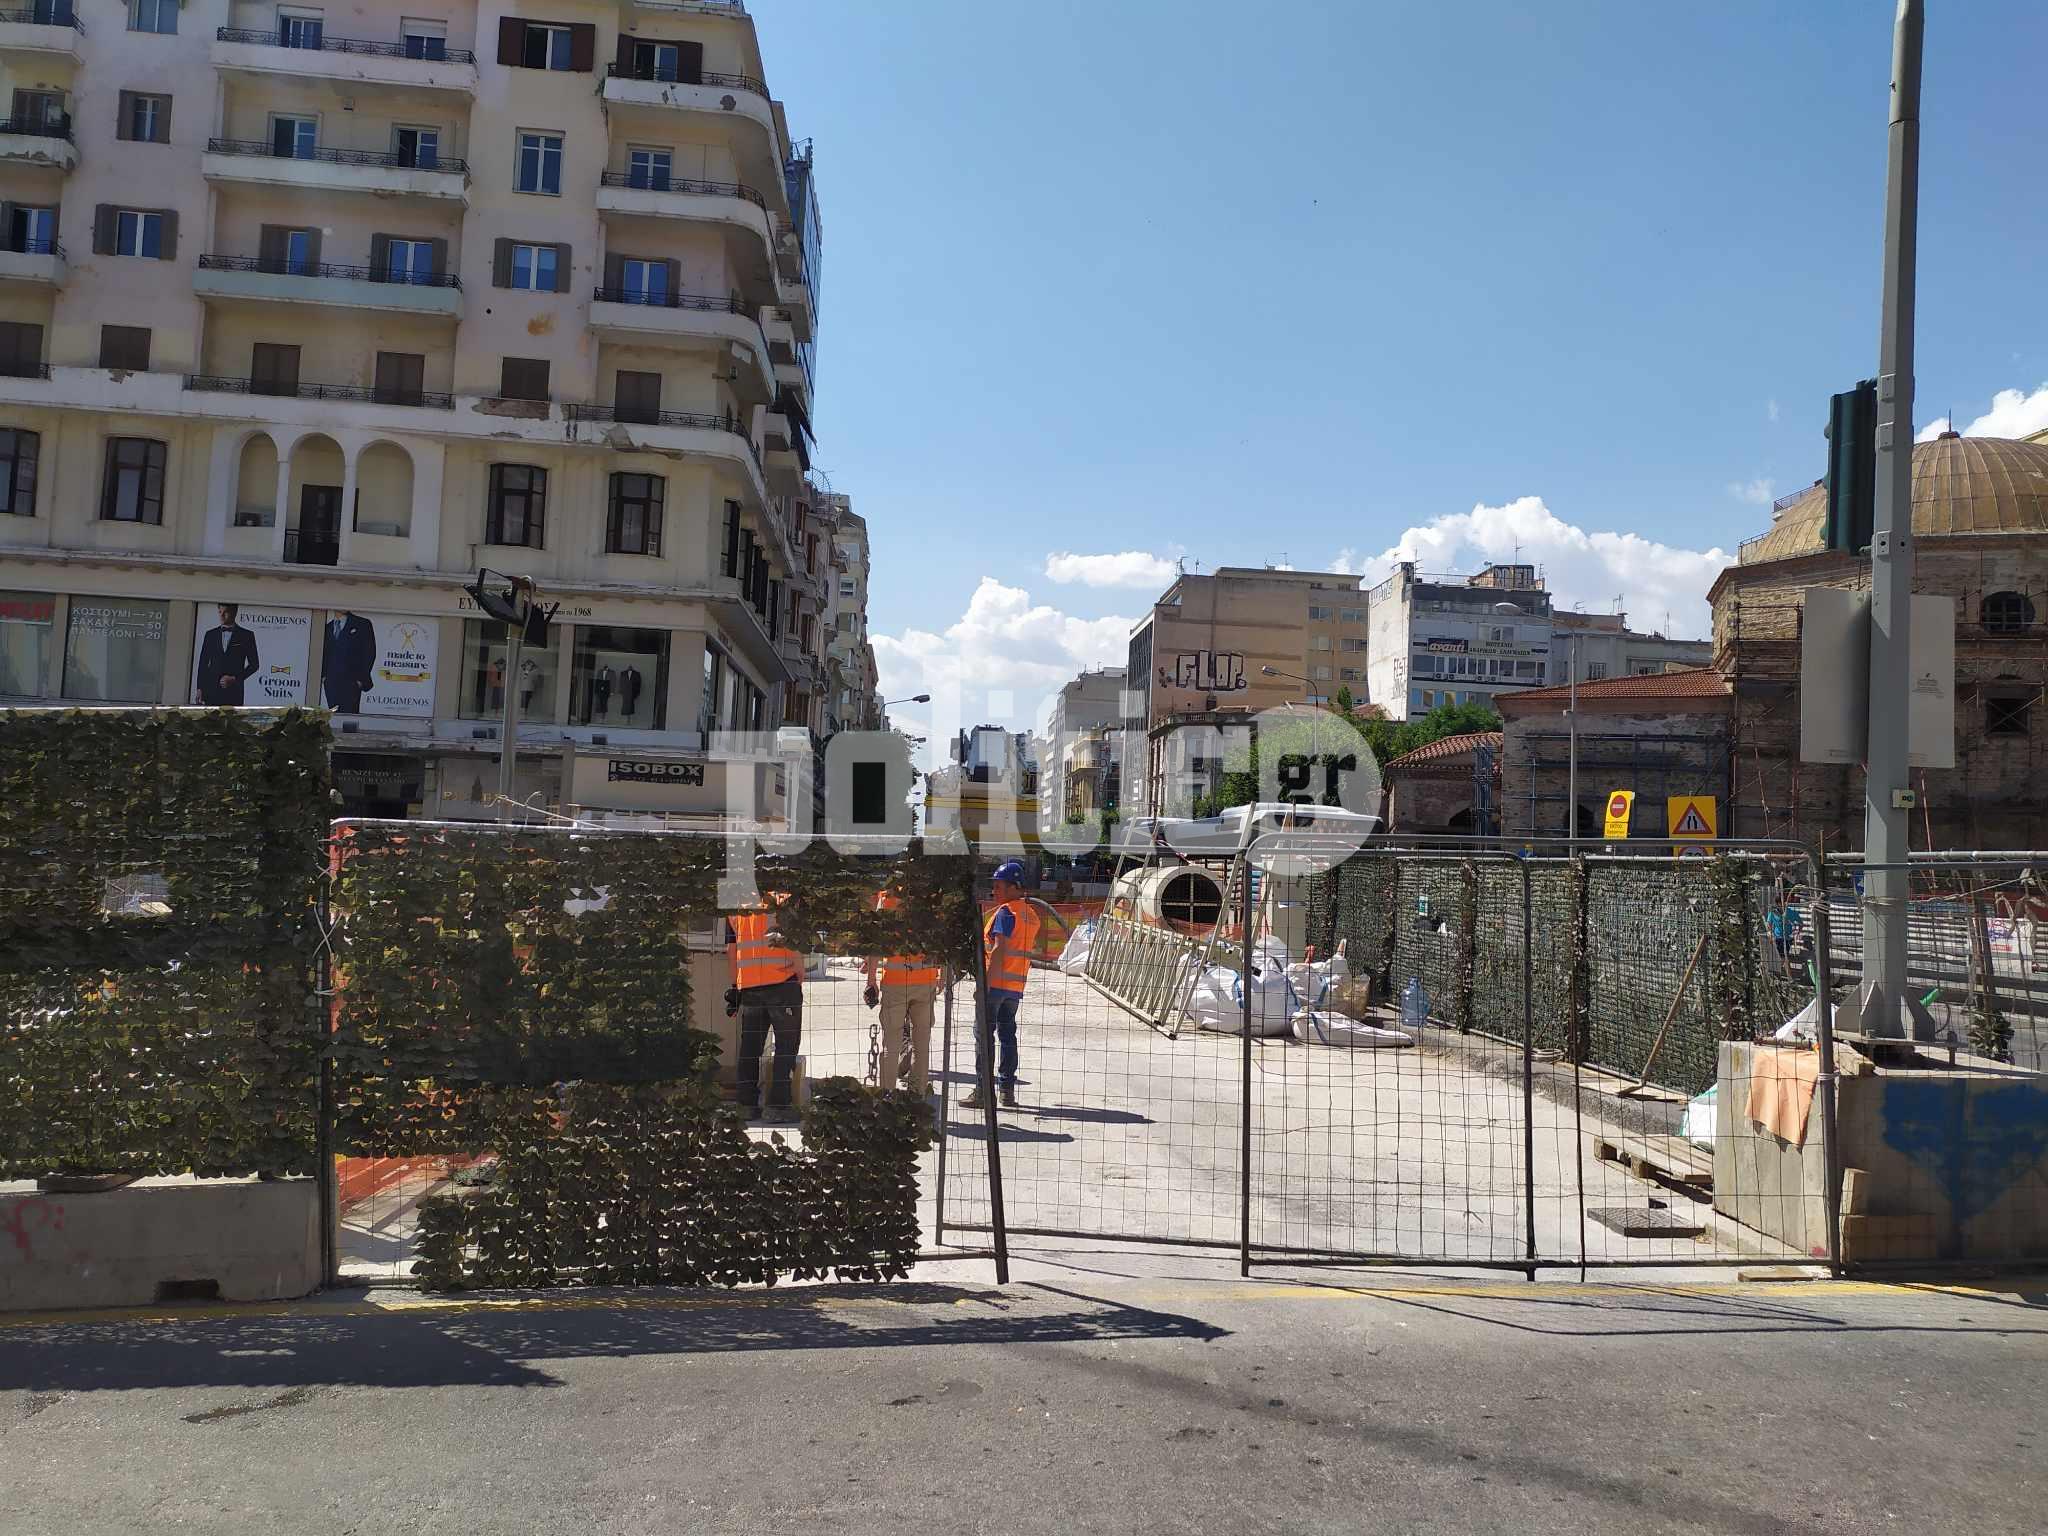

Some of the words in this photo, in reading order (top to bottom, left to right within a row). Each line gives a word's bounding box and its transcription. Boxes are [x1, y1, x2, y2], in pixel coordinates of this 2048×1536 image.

[574, 607, 592, 617] 1968
[240, 613, 307, 625] EVLOGIMENOS
[387, 650, 415, 661] made
[416, 651, 425, 660] to
[383, 660, 428, 669] measure
[259, 675, 300, 688] Groom
[264, 687, 293, 698] Suits
[366, 695, 429, 706] EVLOGIMENOS
[610, 761, 702, 777] ISOBOX
